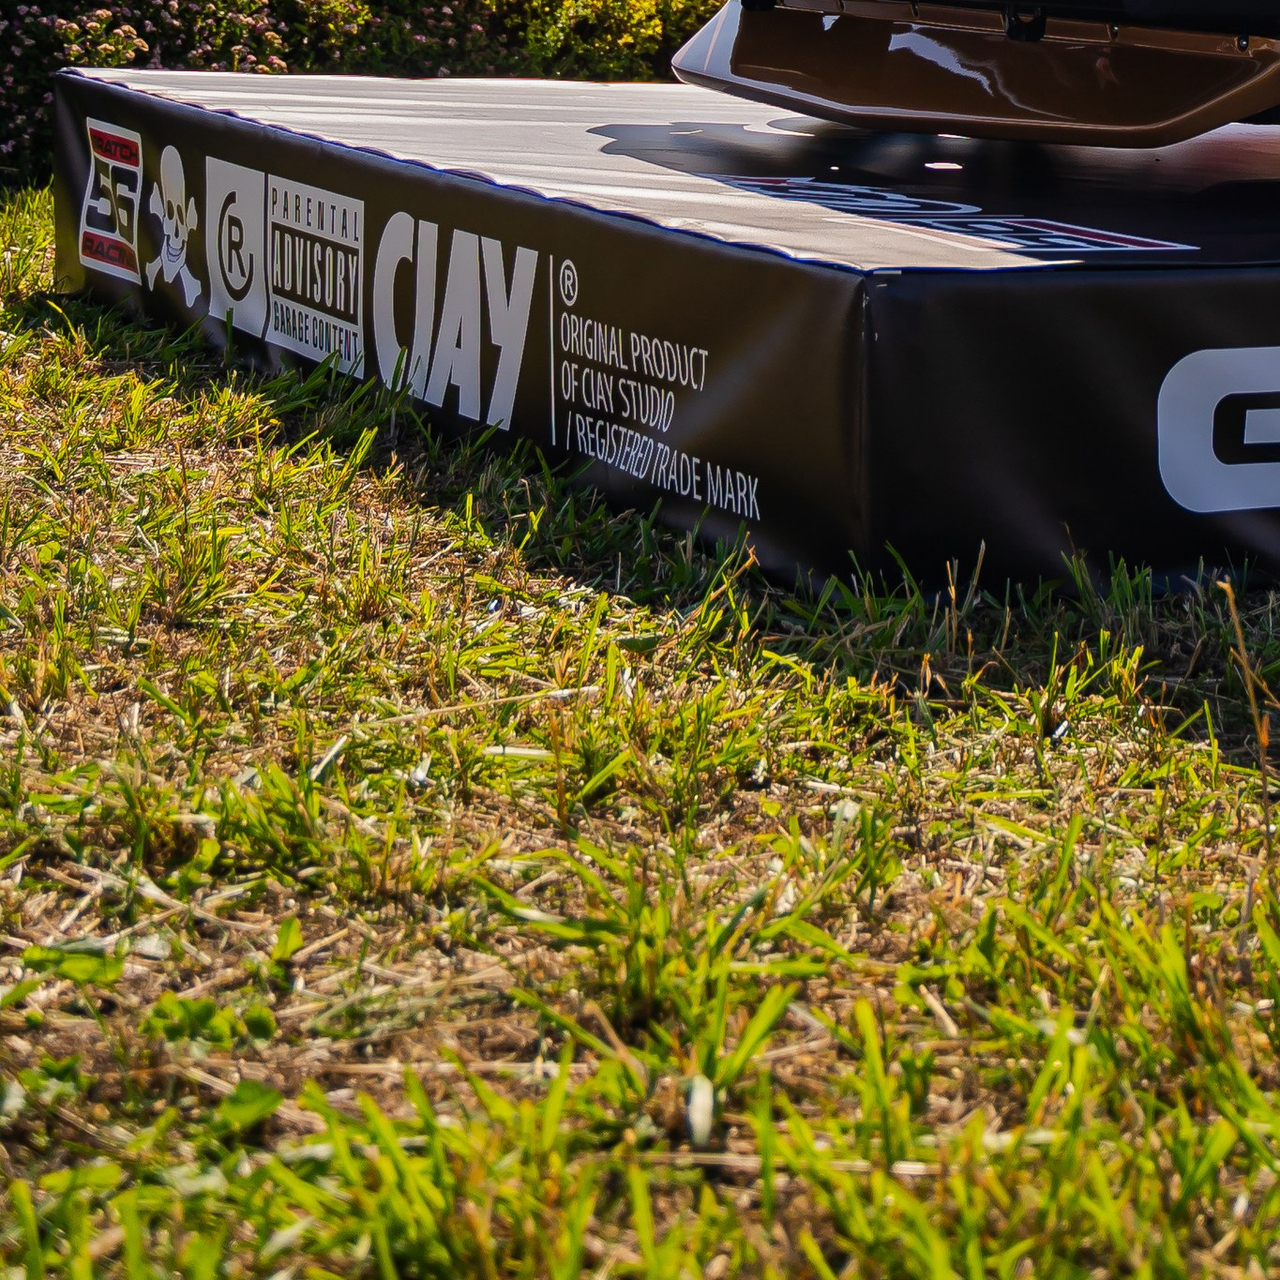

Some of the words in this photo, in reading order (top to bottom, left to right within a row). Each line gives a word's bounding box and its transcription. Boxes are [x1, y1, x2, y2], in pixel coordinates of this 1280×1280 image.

[272, 187, 359, 242] PARENTAL
[273, 229, 359, 315] ADVISORY
[273, 300, 310, 345] GARAGE
[312, 315, 359, 362] CONTENT
[561, 311, 628, 370] ORIGINAL
[630, 332, 709, 392] PRODUCT
[561, 360, 579, 402] OF
[619, 377, 676, 434] STUDIO
[576, 412, 654, 480] REGISTERED
[651, 442, 703, 501] TRADE
[707, 461, 761, 521] MARK
